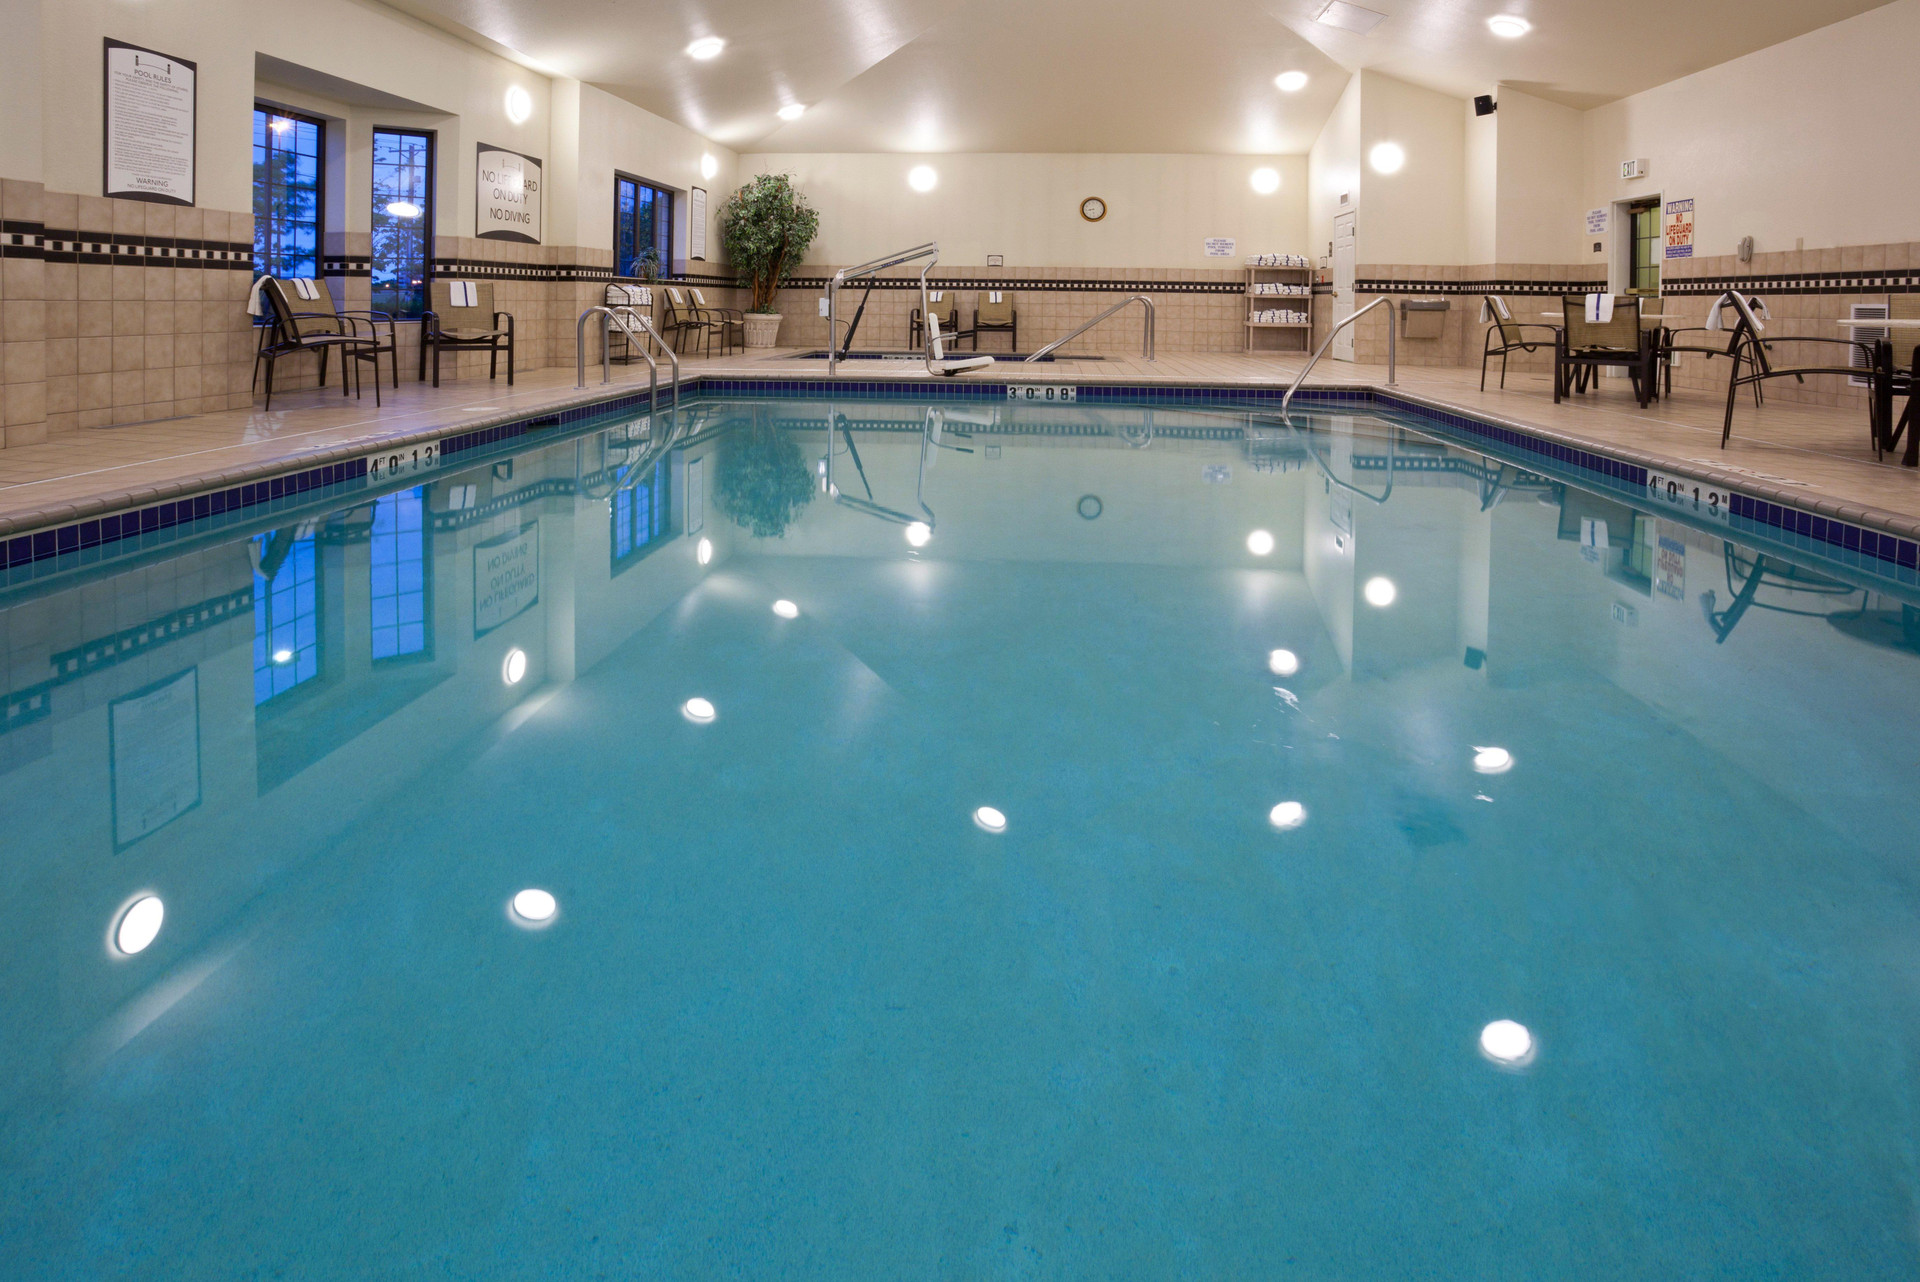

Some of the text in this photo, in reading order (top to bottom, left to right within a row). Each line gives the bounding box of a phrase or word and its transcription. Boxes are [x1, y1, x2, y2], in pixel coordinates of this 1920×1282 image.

[134, 69, 171, 83] POOL RULES
[1623, 160, 1635, 177] EXIT
[136, 176, 169, 187] WARNING
[482, 170, 496, 183] NO
[493, 188, 528, 205] ON DUTY
[1667, 200, 1693, 214] WARNING
[490, 208, 530, 224] NO DIVING
[1676, 213, 1683, 223] NO
[1666, 223, 1692, 235] LIFEGUARD
[1669, 234, 1689, 245] ON DUTY
[370, 458, 379, 473] 4
[379, 457, 386, 465] FT
[1649, 475, 1657, 489] 4
[1657, 476, 1664, 486] FT
[1678, 483, 1684, 492] IN
[1722, 494, 1728, 504] M
